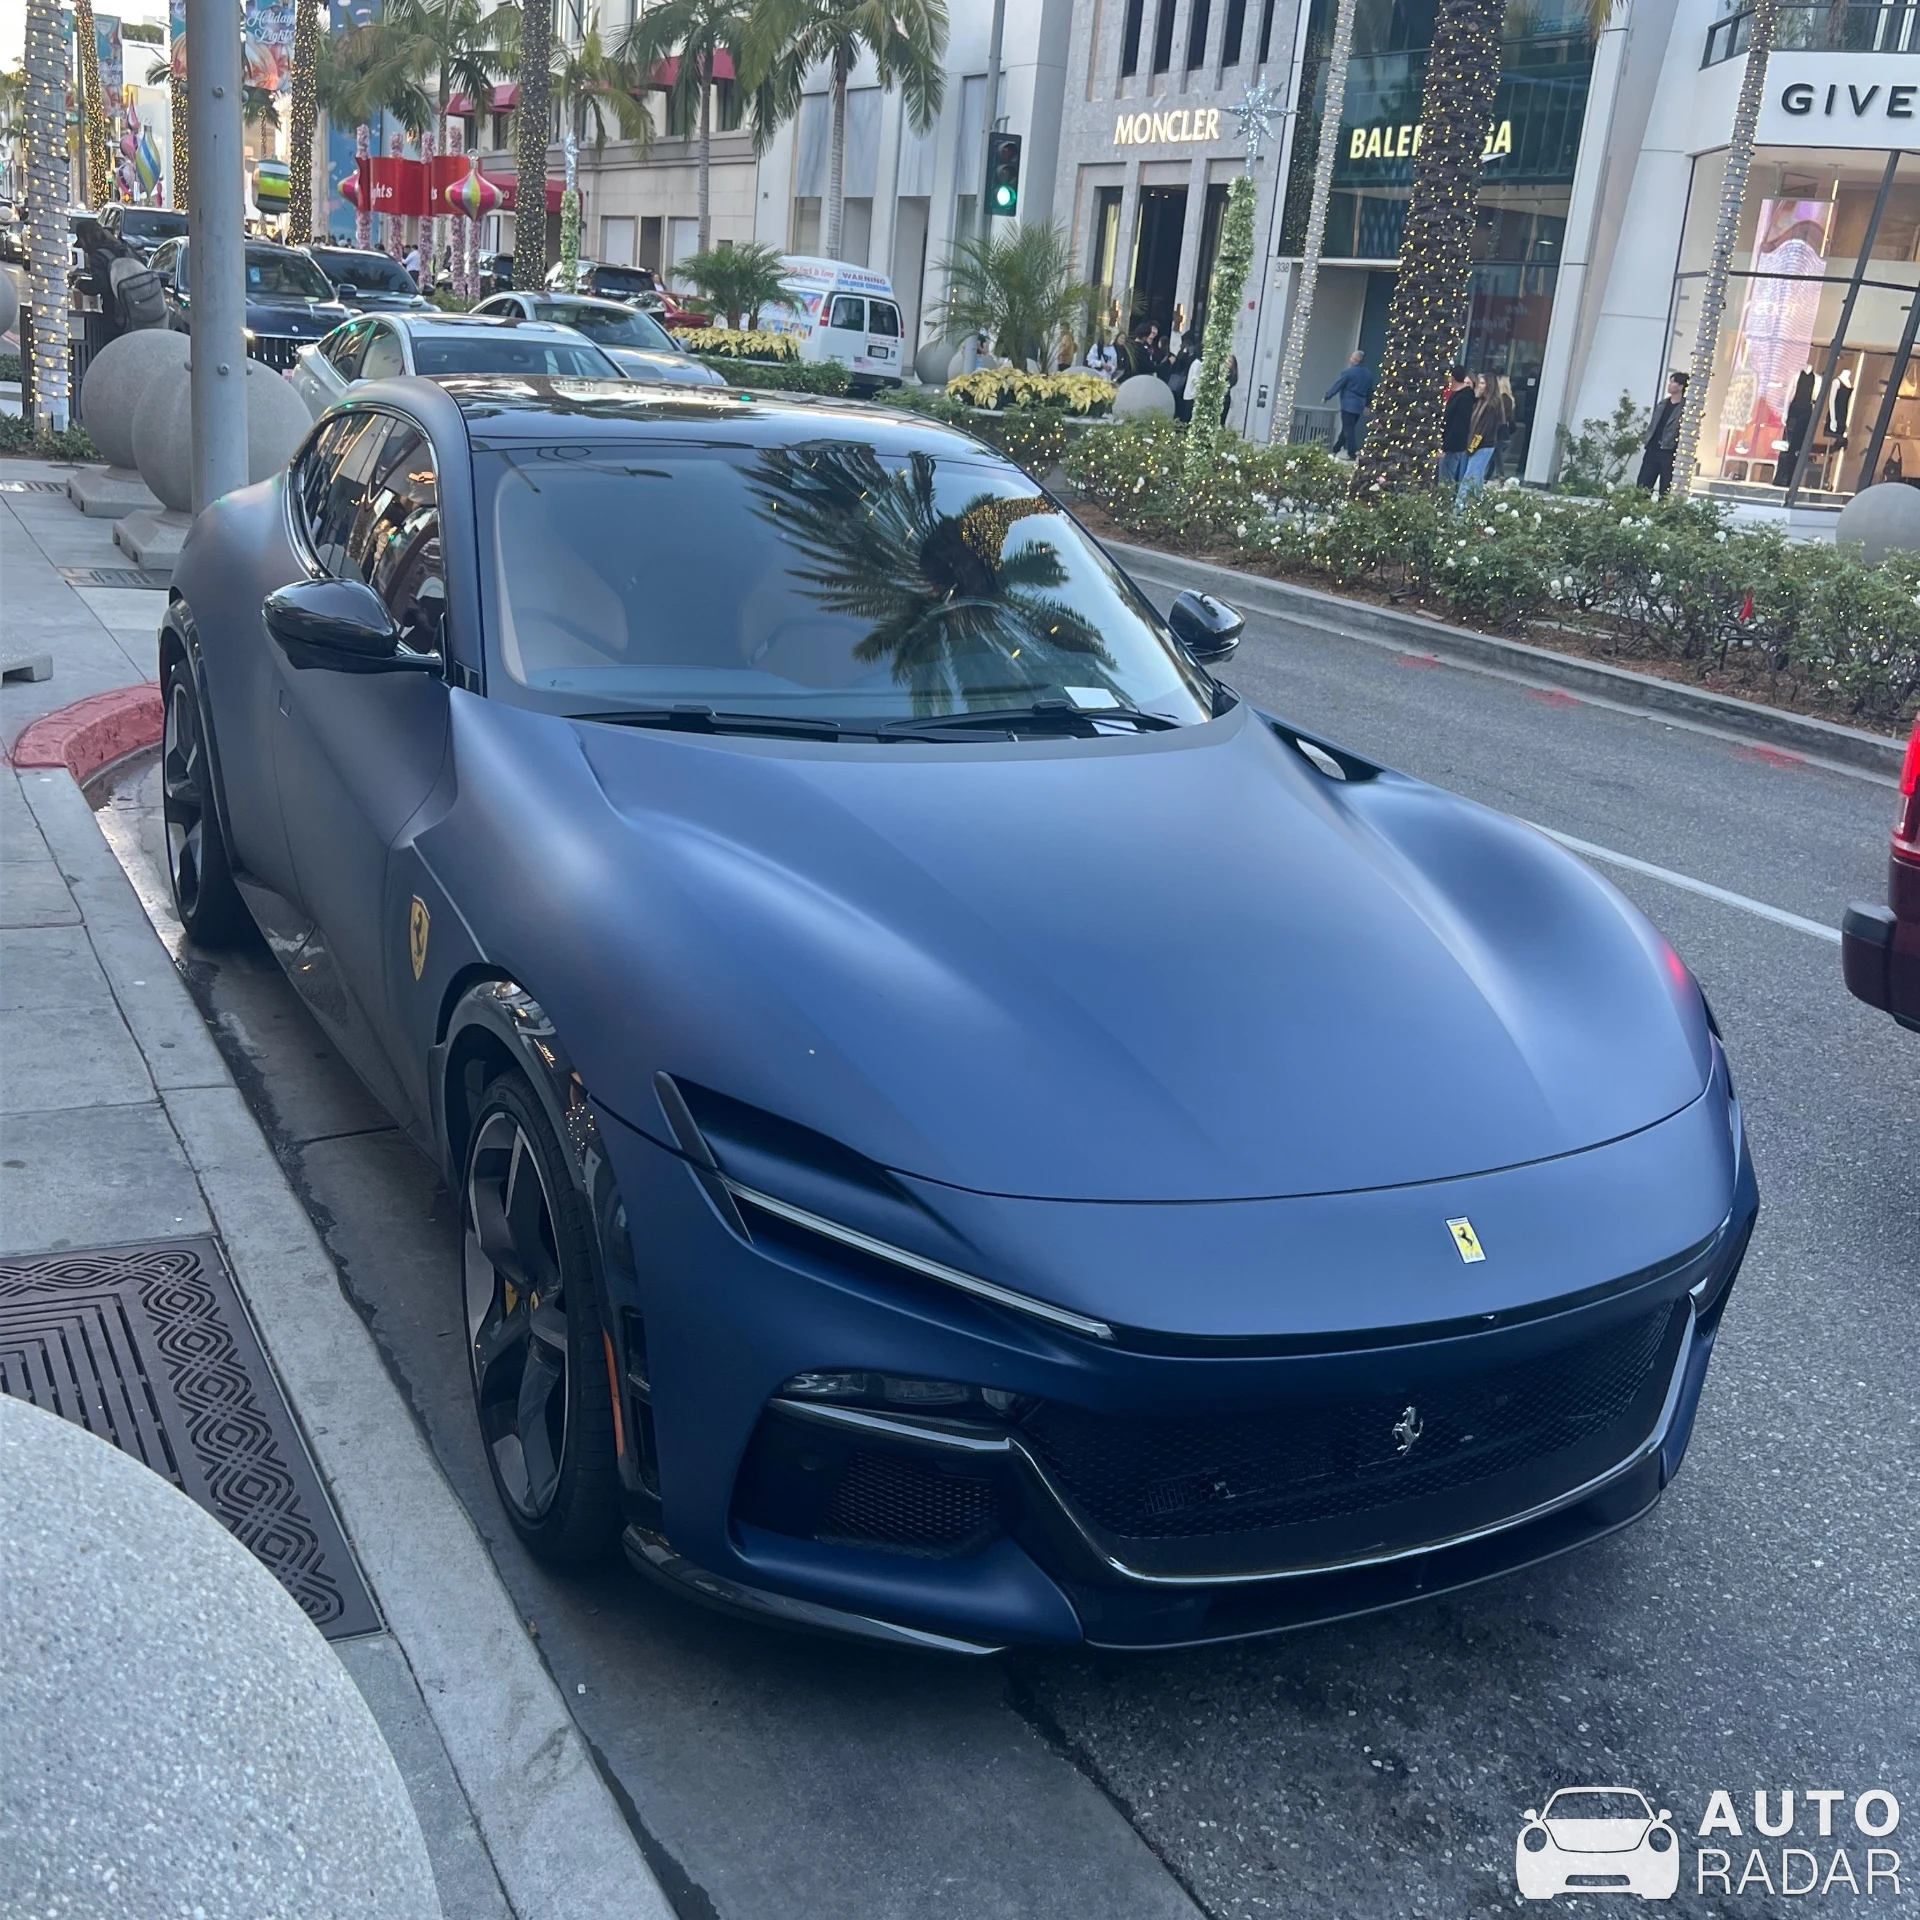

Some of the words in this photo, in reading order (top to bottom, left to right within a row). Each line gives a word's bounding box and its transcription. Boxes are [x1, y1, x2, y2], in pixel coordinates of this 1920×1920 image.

[246, 10, 296, 30] Holiday
[254, 28, 293, 45] Lights
[1781, 83, 1918, 118] GIVE
[1113, 107, 1221, 145] MONCLER
[1276, 261, 1290, 273] 338
[842, 272, 886, 285] WARNING
